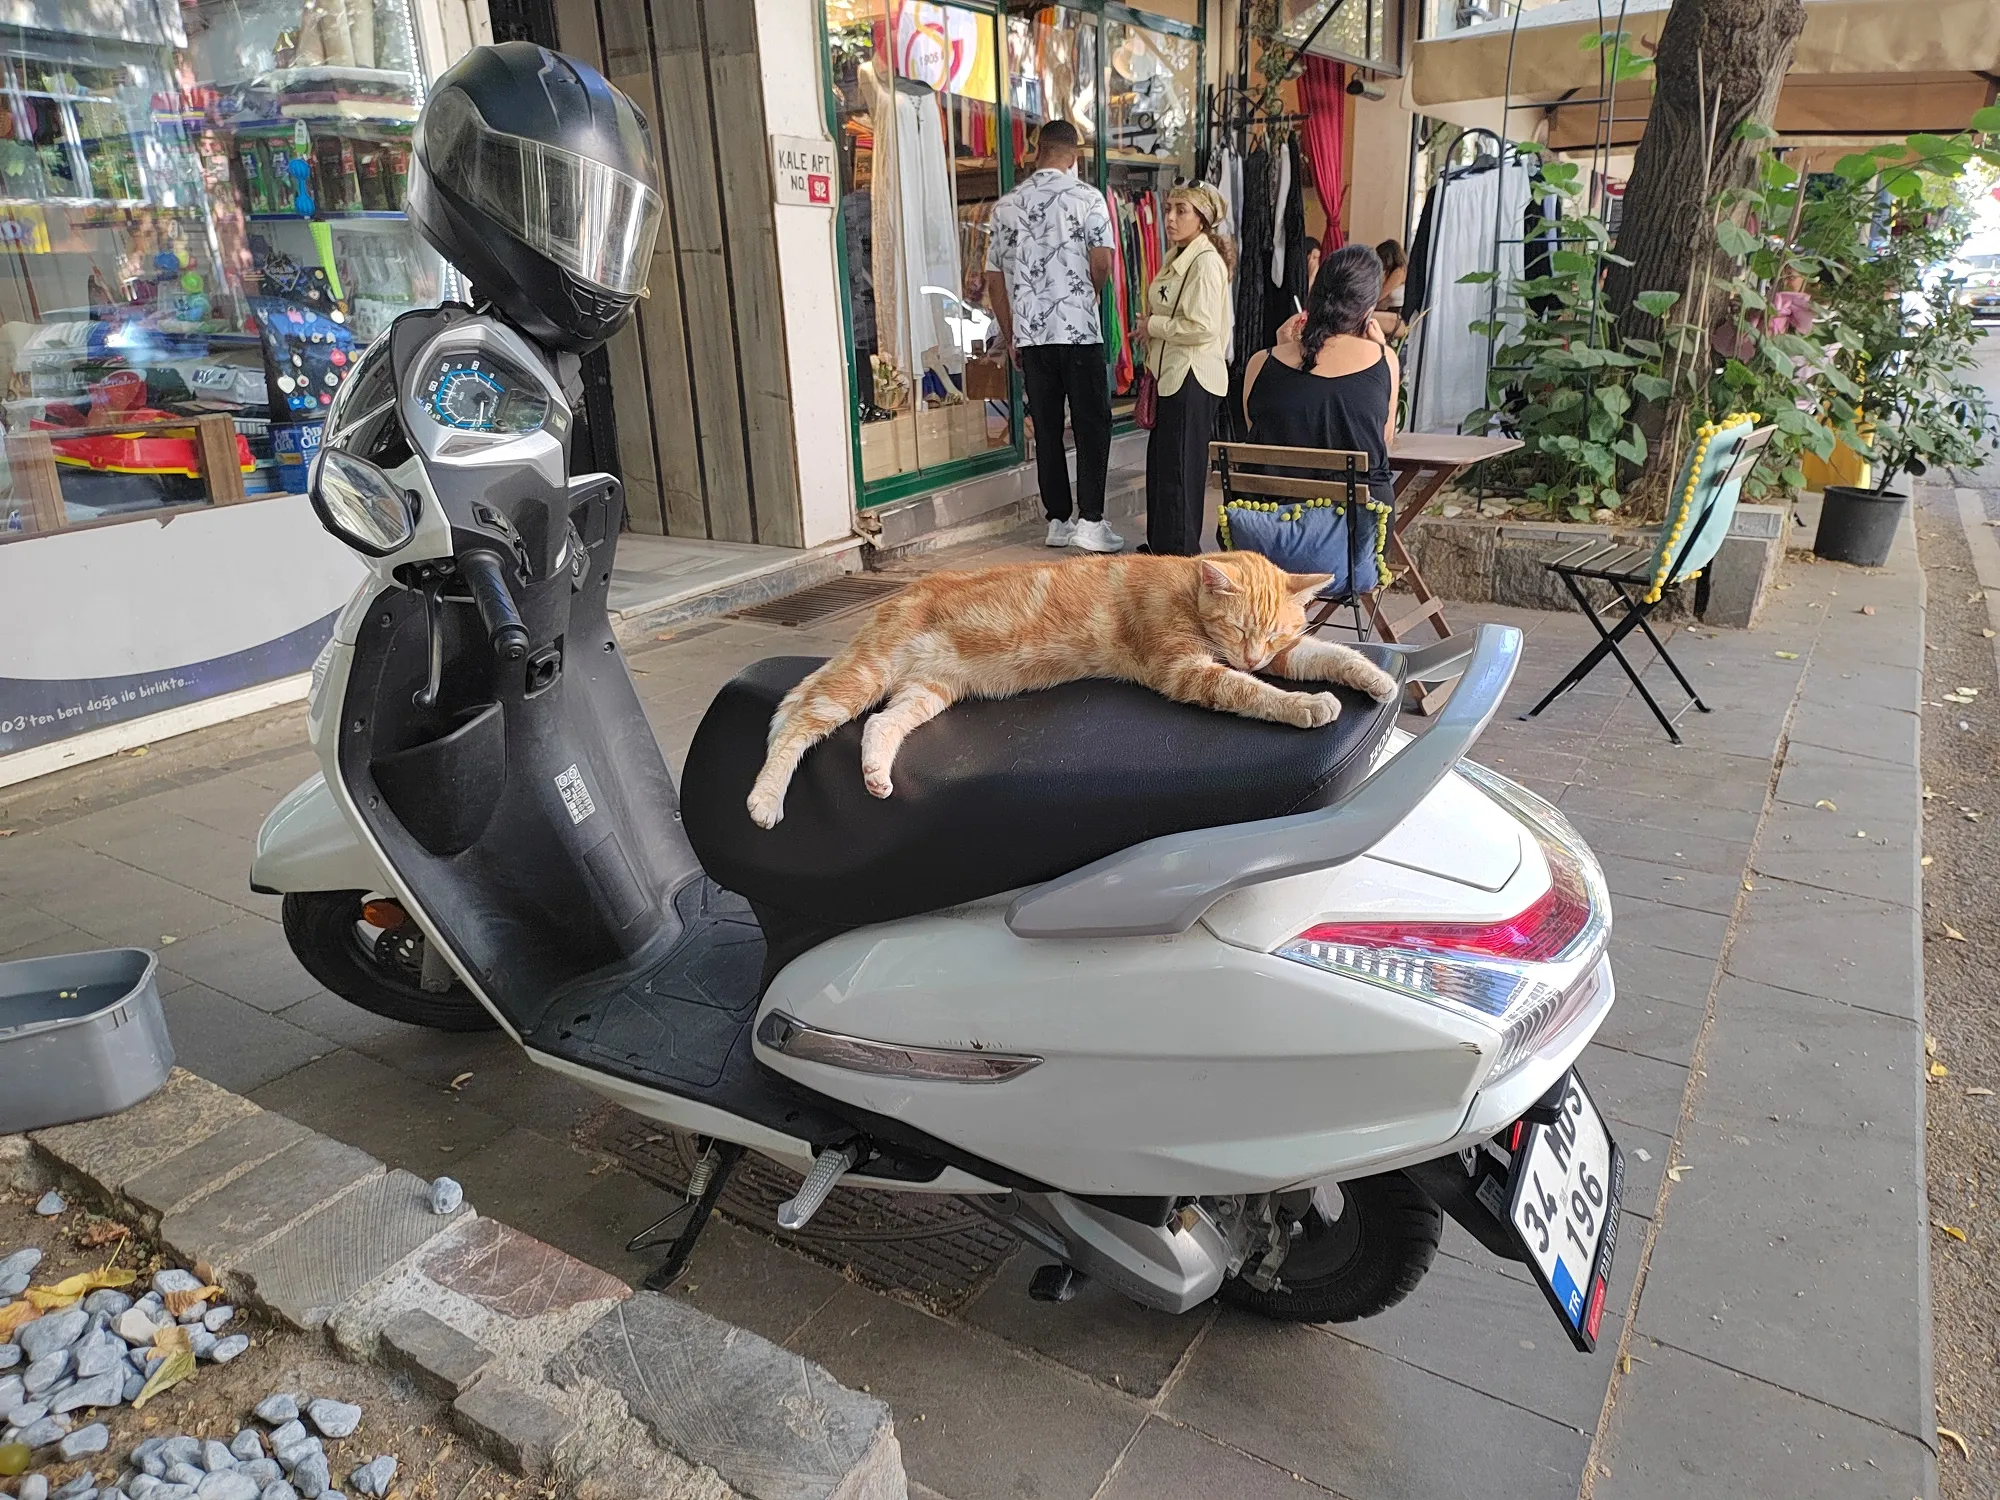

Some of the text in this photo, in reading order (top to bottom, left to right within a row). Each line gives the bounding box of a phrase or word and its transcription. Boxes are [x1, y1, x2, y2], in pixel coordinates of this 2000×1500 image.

[779, 150, 832, 174] KALE APT.
[790, 175, 827, 198] NO. 92
[0, 715, 55, 733] 03'ten
[57, 702, 84, 719] beri
[87, 694, 119, 711] doğa
[120, 689, 136, 702] ile
[1524, 1169, 1558, 1254] 34
[1565, 1161, 1604, 1262] 196
[1568, 1289, 1582, 1318] TR
